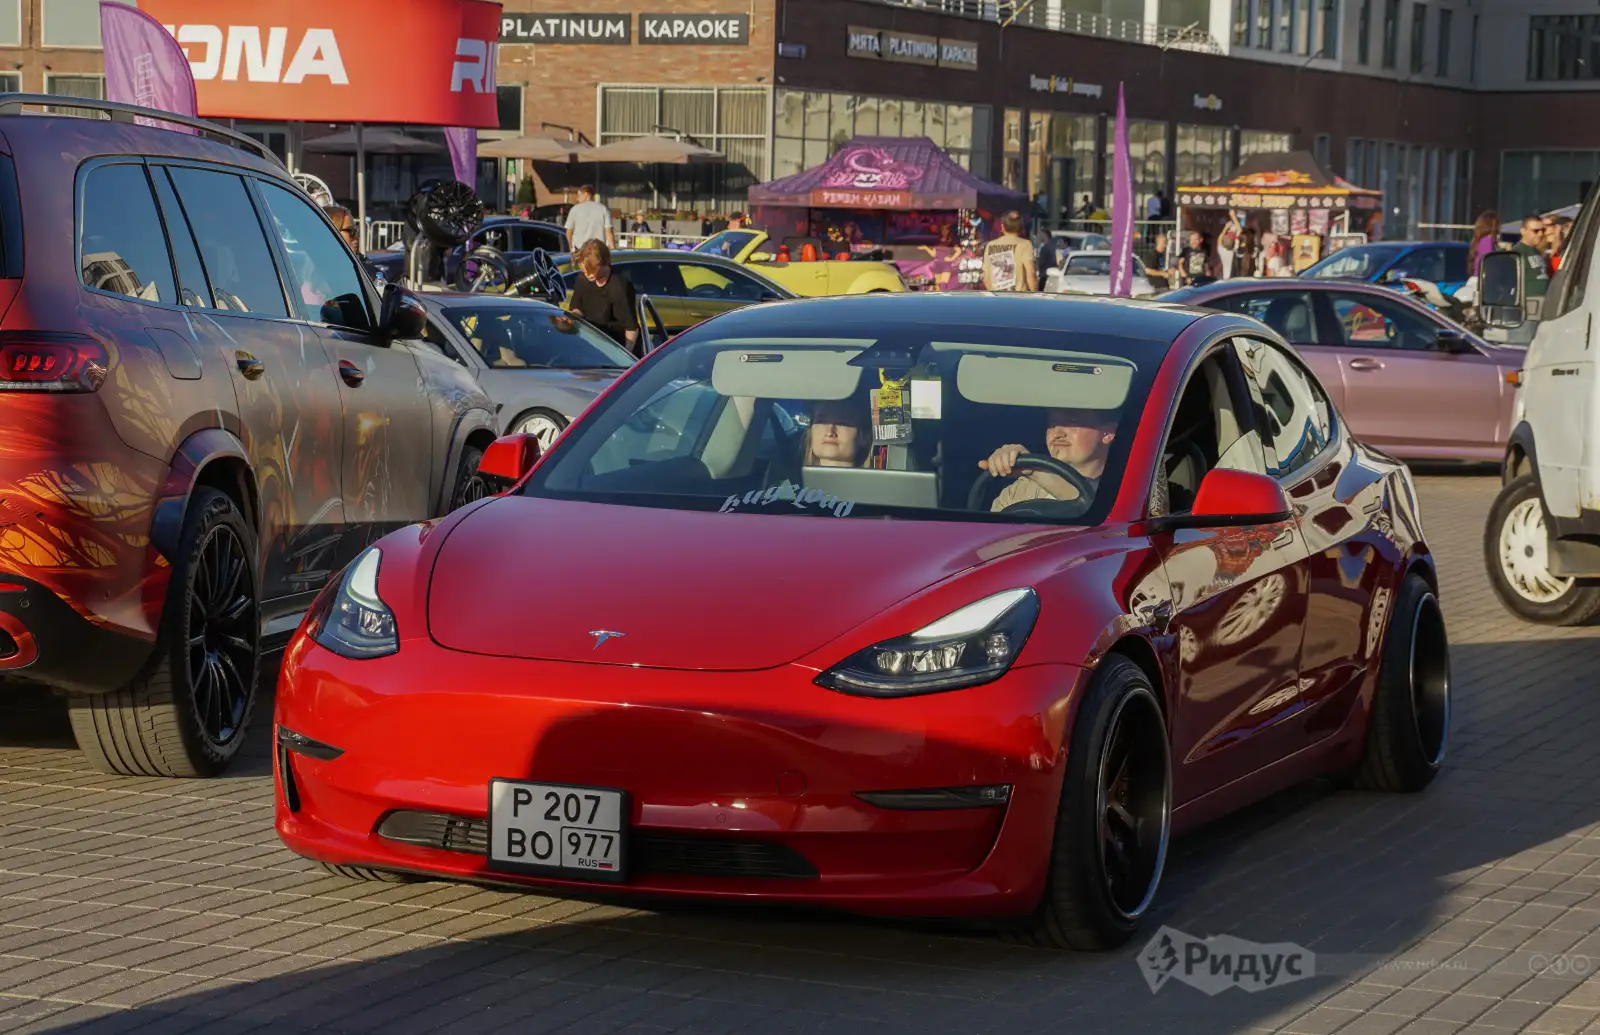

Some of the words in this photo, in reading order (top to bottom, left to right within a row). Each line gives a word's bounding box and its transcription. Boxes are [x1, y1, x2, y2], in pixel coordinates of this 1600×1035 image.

[502, 18, 625, 38] PLATINUM
[644, 19, 740, 39] КАРАОКЕ
[163, 24, 350, 85] ONA
[889, 38, 938, 60] PLATINUM
[543, 791, 601, 825] 207
[567, 832, 614, 859] 977
[578, 857, 598, 868] RUS
